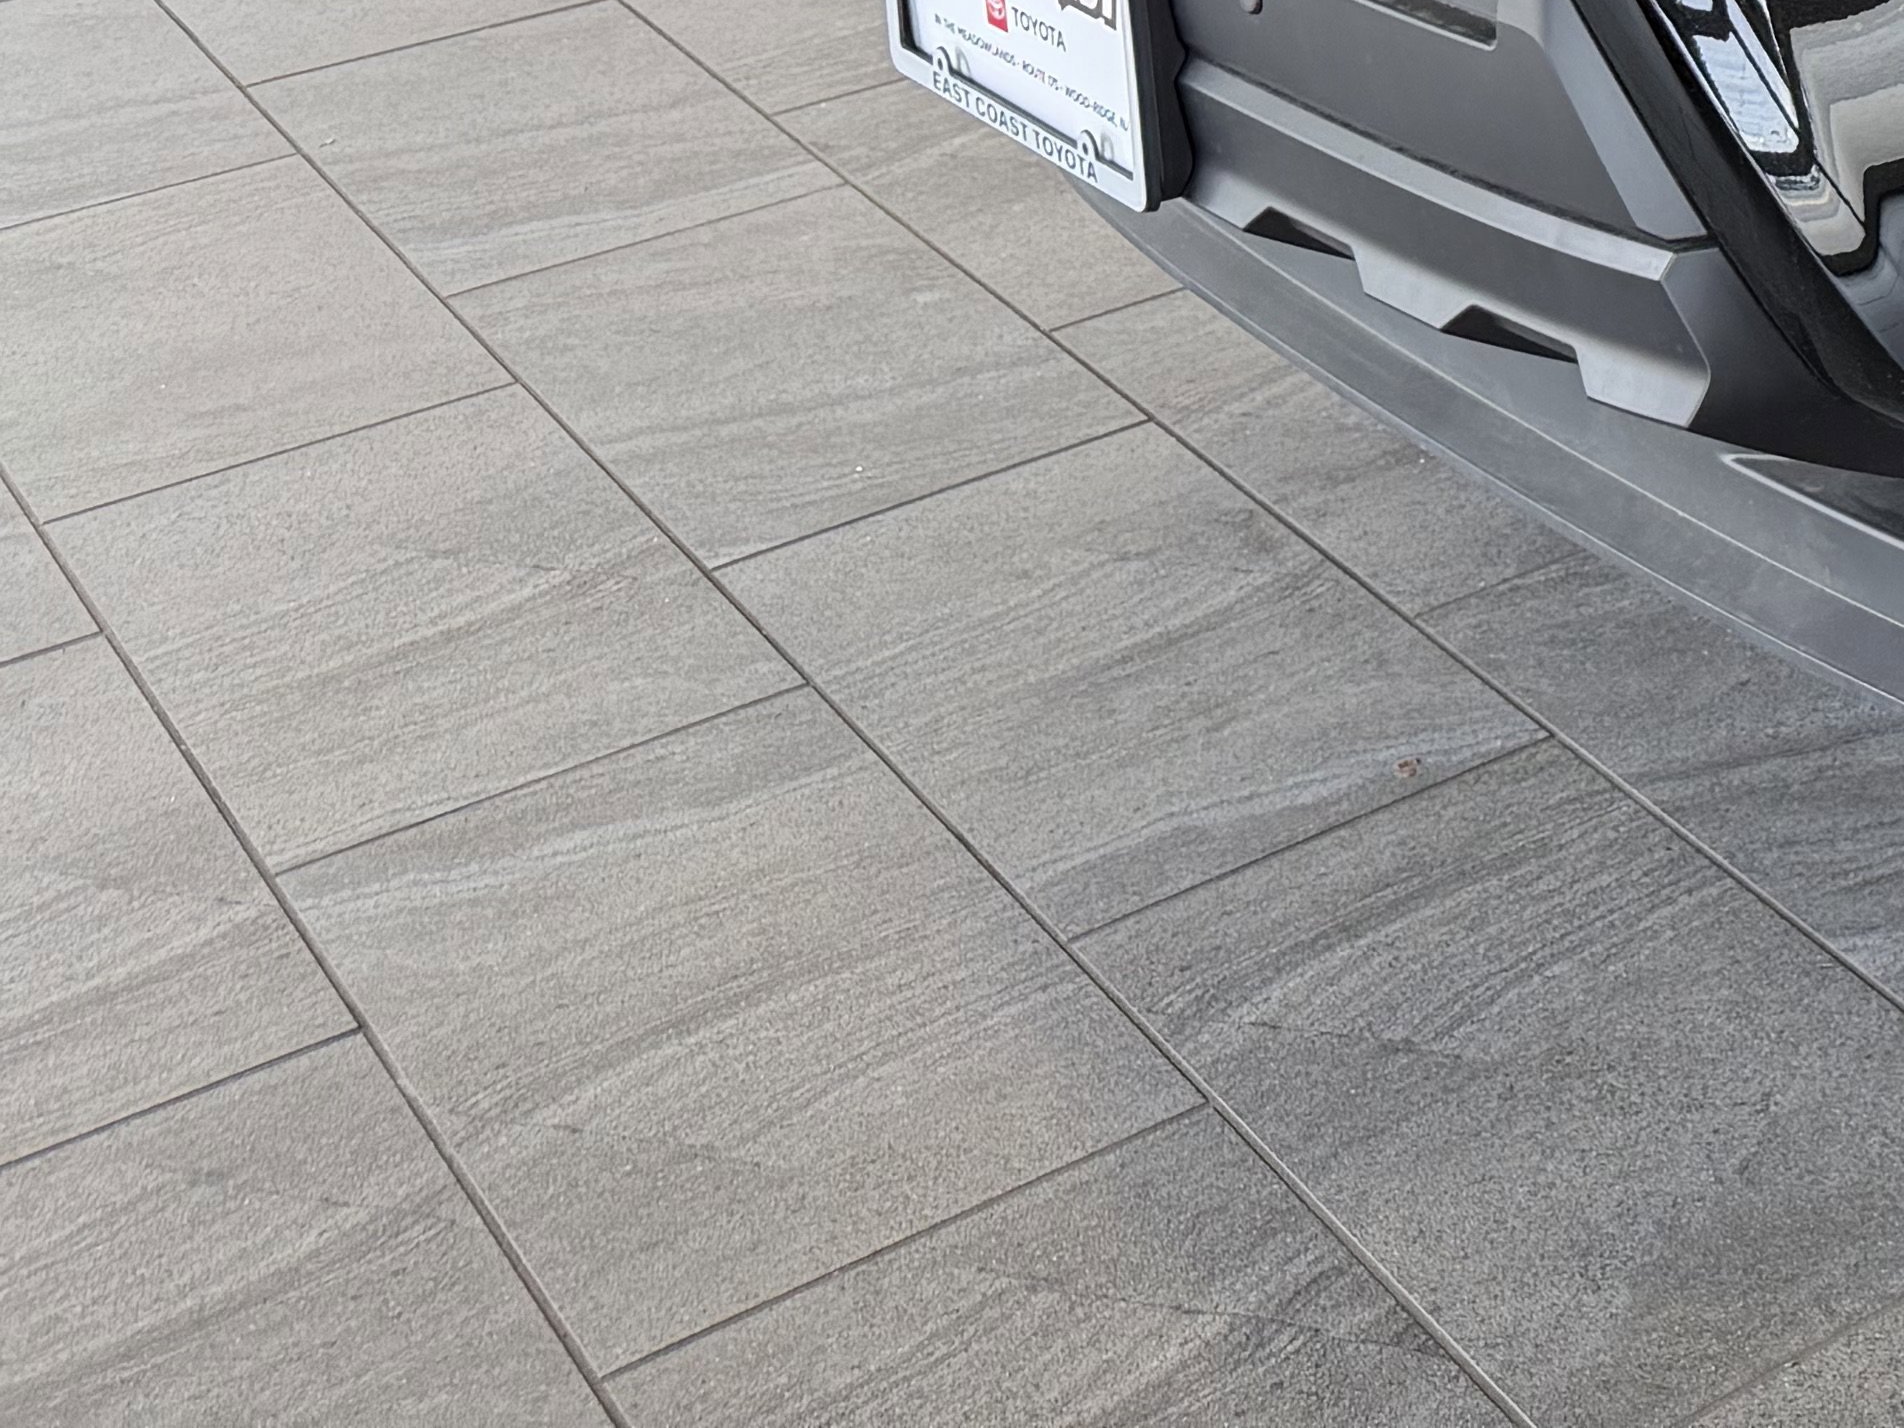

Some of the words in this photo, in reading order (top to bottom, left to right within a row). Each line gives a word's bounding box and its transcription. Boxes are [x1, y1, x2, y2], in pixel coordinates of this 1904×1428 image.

[1011, 6, 1067, 53] TOYOTA
[932, 70, 971, 109] EAST
[975, 96, 1029, 142] COAST
[1032, 128, 1098, 184] TOYOTA
